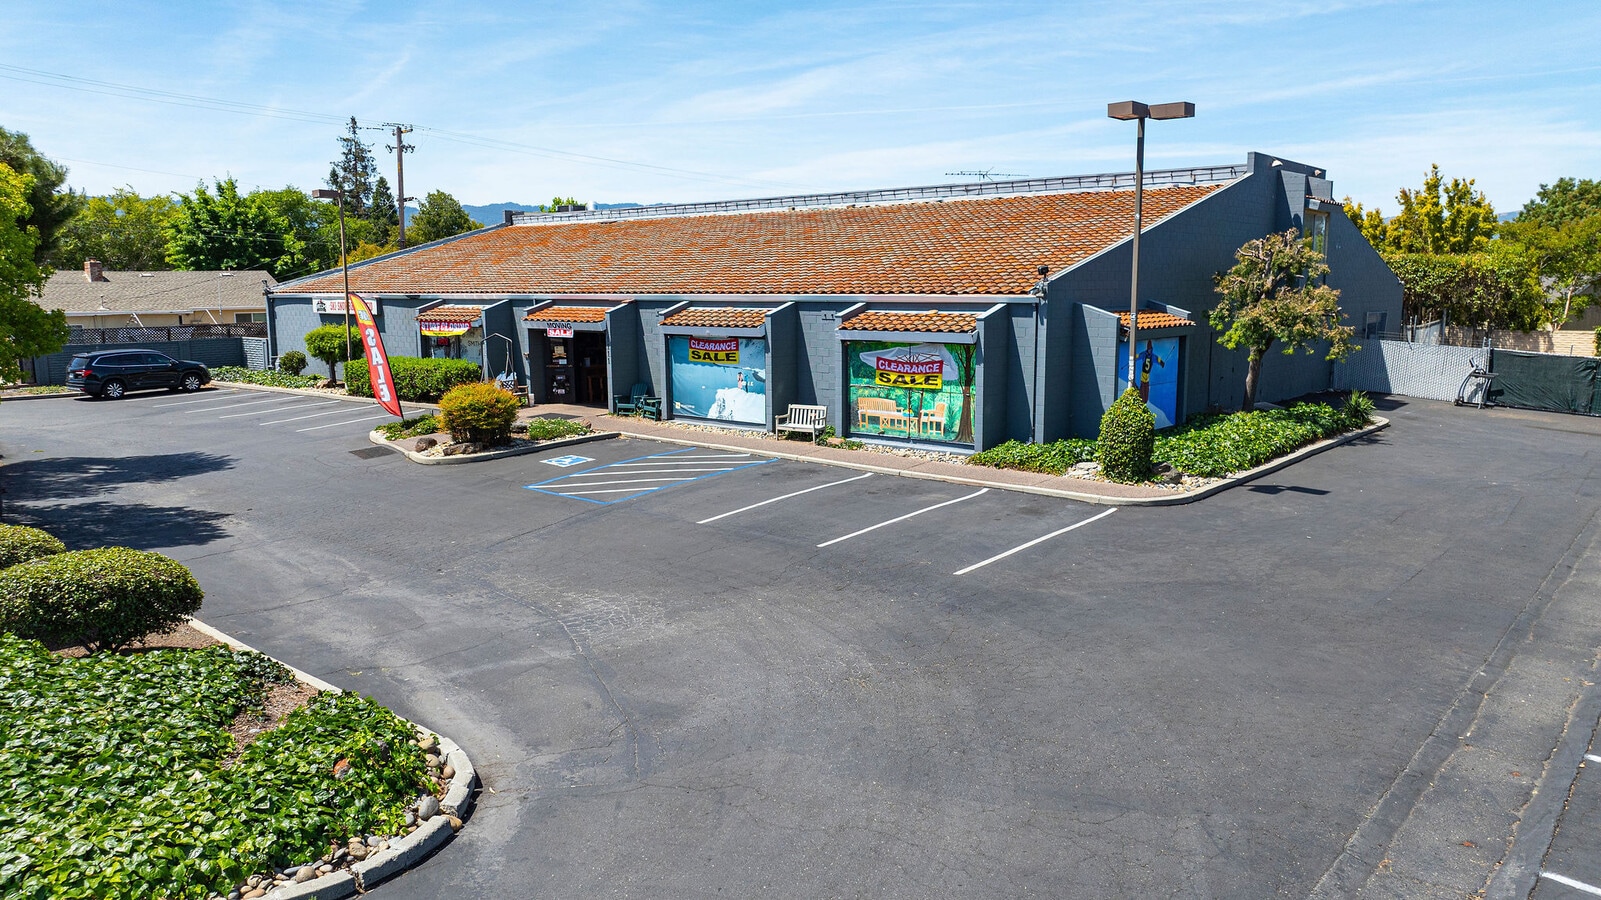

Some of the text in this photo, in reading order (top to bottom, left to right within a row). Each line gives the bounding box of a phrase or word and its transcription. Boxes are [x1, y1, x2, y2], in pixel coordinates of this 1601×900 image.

[546, 322, 572, 330] MOVING
[548, 329, 572, 337] SALE
[690, 339, 737, 351] CLEARANCE
[691, 350, 737, 362] SALE
[878, 359, 940, 374] CLEARANCE
[1144, 358, 1151, 371] 5
[878, 372, 938, 386] SALE
